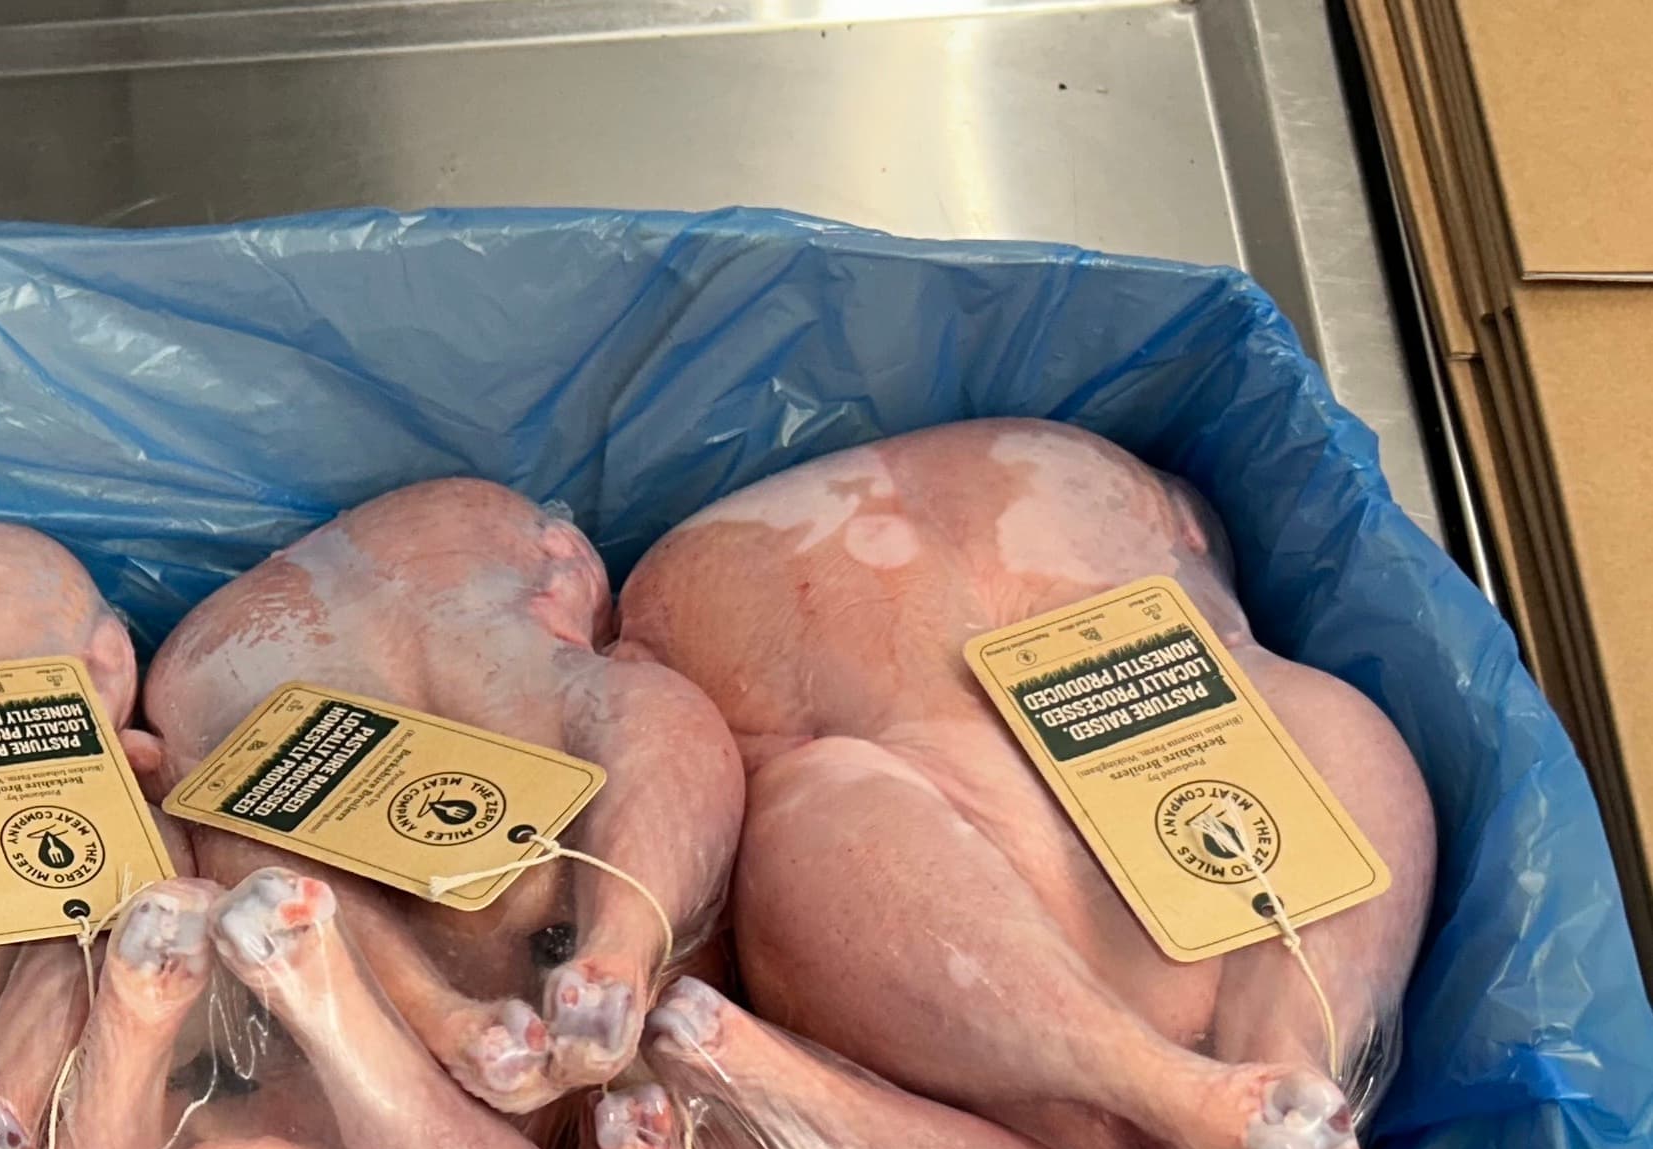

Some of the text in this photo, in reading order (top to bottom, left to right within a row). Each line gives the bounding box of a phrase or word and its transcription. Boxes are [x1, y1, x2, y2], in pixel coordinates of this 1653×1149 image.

[1023, 638, 1199, 711] HONESTLY PRODUCED
[1035, 657, 1212, 728] LOCALLY PROCESSED.
[6, 703, 83, 725] HONESTLY
[24, 717, 89, 738] LOCALLY
[288, 706, 349, 760] HONESTLY
[314, 712, 367, 758] LOCALLY
[1062, 681, 1209, 742] PASTURE RAISED.
[8, 734, 81, 756] PASTURE
[318, 726, 376, 776] PASTURE
[1108, 735, 1228, 781] Berkshire Broilers
[24, 776, 85, 790] Berkshire
[233, 758, 297, 814] PRODUCED
[250, 755, 324, 817] PROCESSED.
[277, 773, 329, 814] RAISED.
[334, 749, 414, 823] Berkshire Broilers
[394, 776, 464, 833] MEAT COMPANY
[6, 810, 92, 845] MEAT COMPANY
[422, 781, 500, 841] THE ZERO MILES
[1162, 786, 1206, 836] COMPANY
[1253, 818, 1273, 847] THE
[12, 841, 98, 883] THE ZERO MILES
[1176, 845, 1226, 877] MILES
